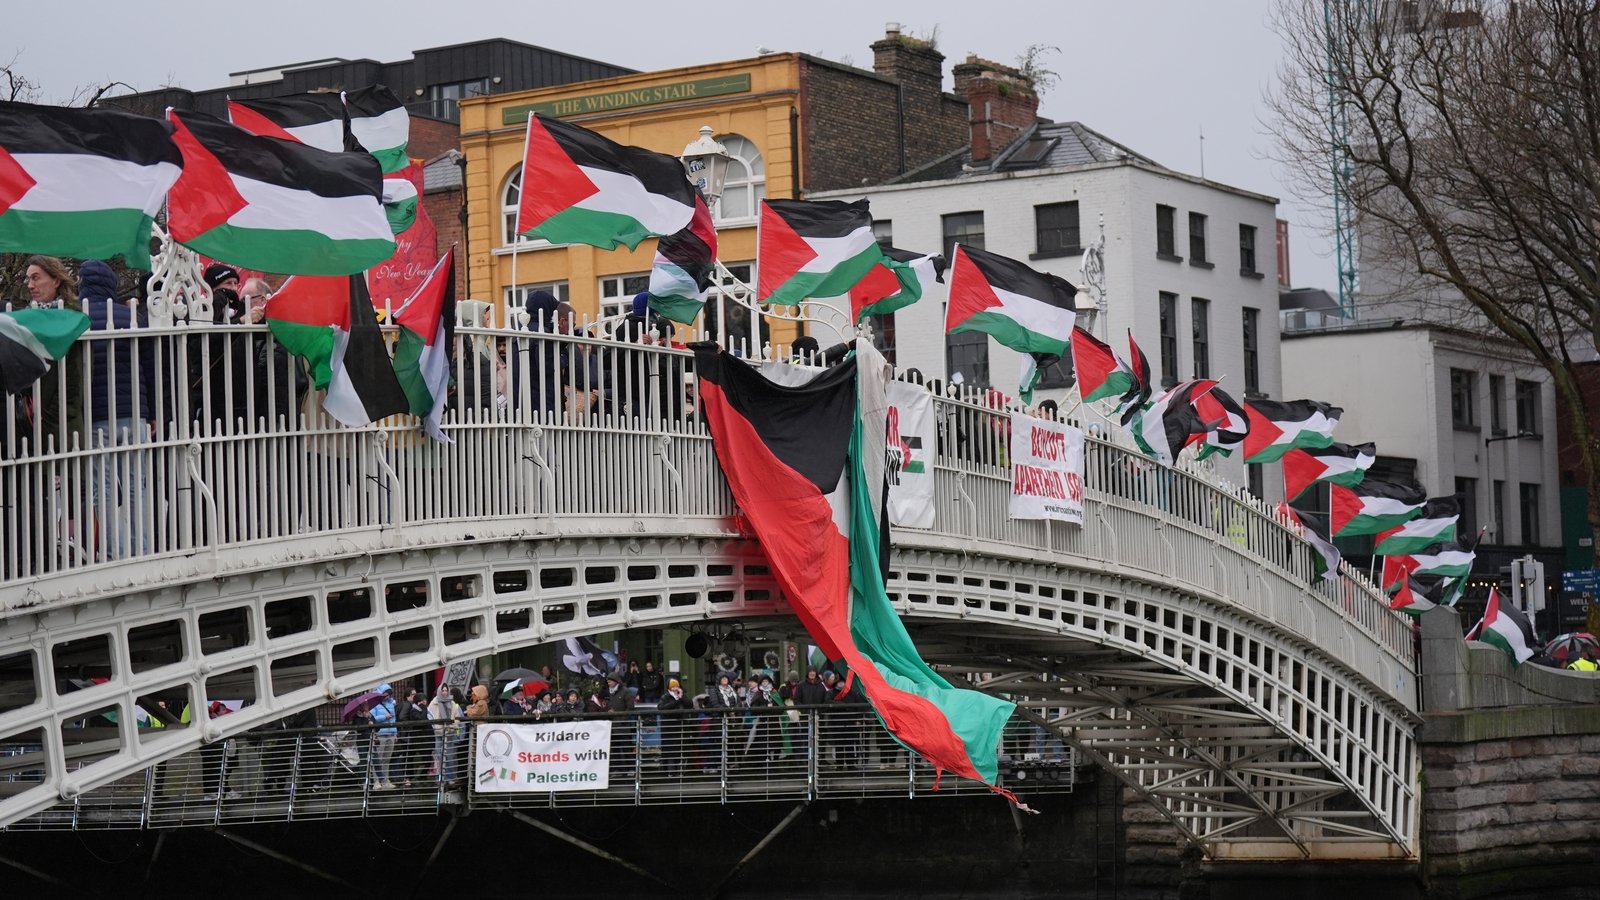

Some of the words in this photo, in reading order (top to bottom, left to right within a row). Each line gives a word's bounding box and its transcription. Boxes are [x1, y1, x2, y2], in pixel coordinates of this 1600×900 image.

[553, 98, 581, 115] THE
[585, 90, 651, 110] WINDING
[654, 83, 697, 101] STAIR
[376, 264, 401, 279] New
[1031, 425, 1067, 463] BOYCOTT
[1014, 463, 1066, 500] APARTHEID
[535, 731, 590, 742] Kildare
[517, 751, 570, 763] Stands
[574, 749, 608, 761] with
[527, 770, 598, 783] Palestine
